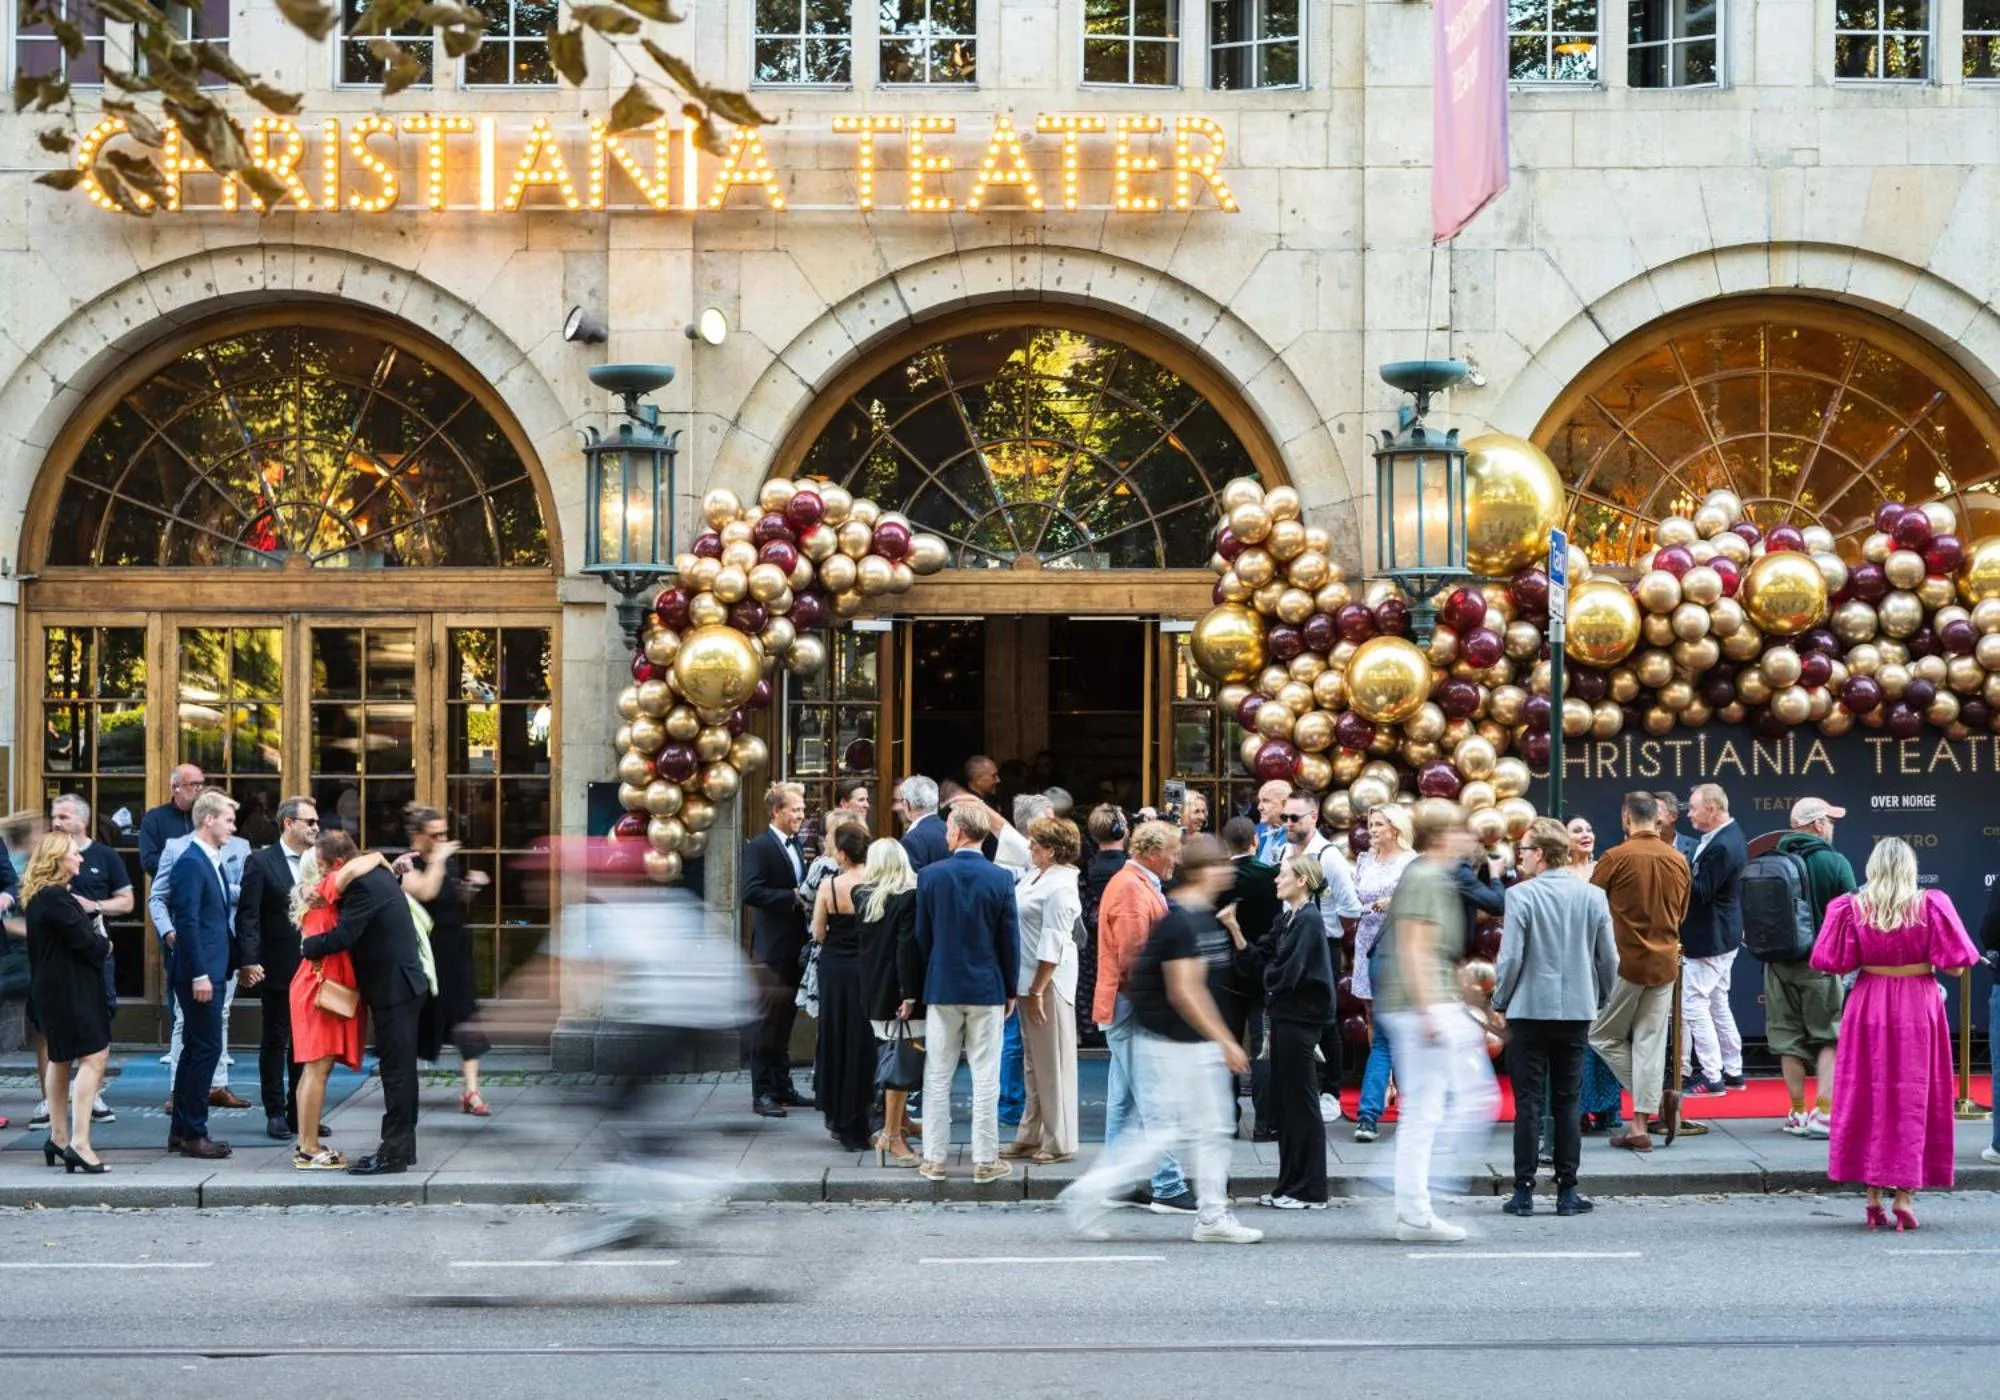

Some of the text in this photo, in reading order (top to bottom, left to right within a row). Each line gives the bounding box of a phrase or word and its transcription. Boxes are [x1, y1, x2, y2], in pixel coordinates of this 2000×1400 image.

[77, 115, 1240, 213] CHRISTIANIA TEATER
[1530, 733, 1836, 779] HRISTIANIA
[1752, 796, 1801, 811] TEAT
[1871, 794, 1937, 808] OVER NORGE
